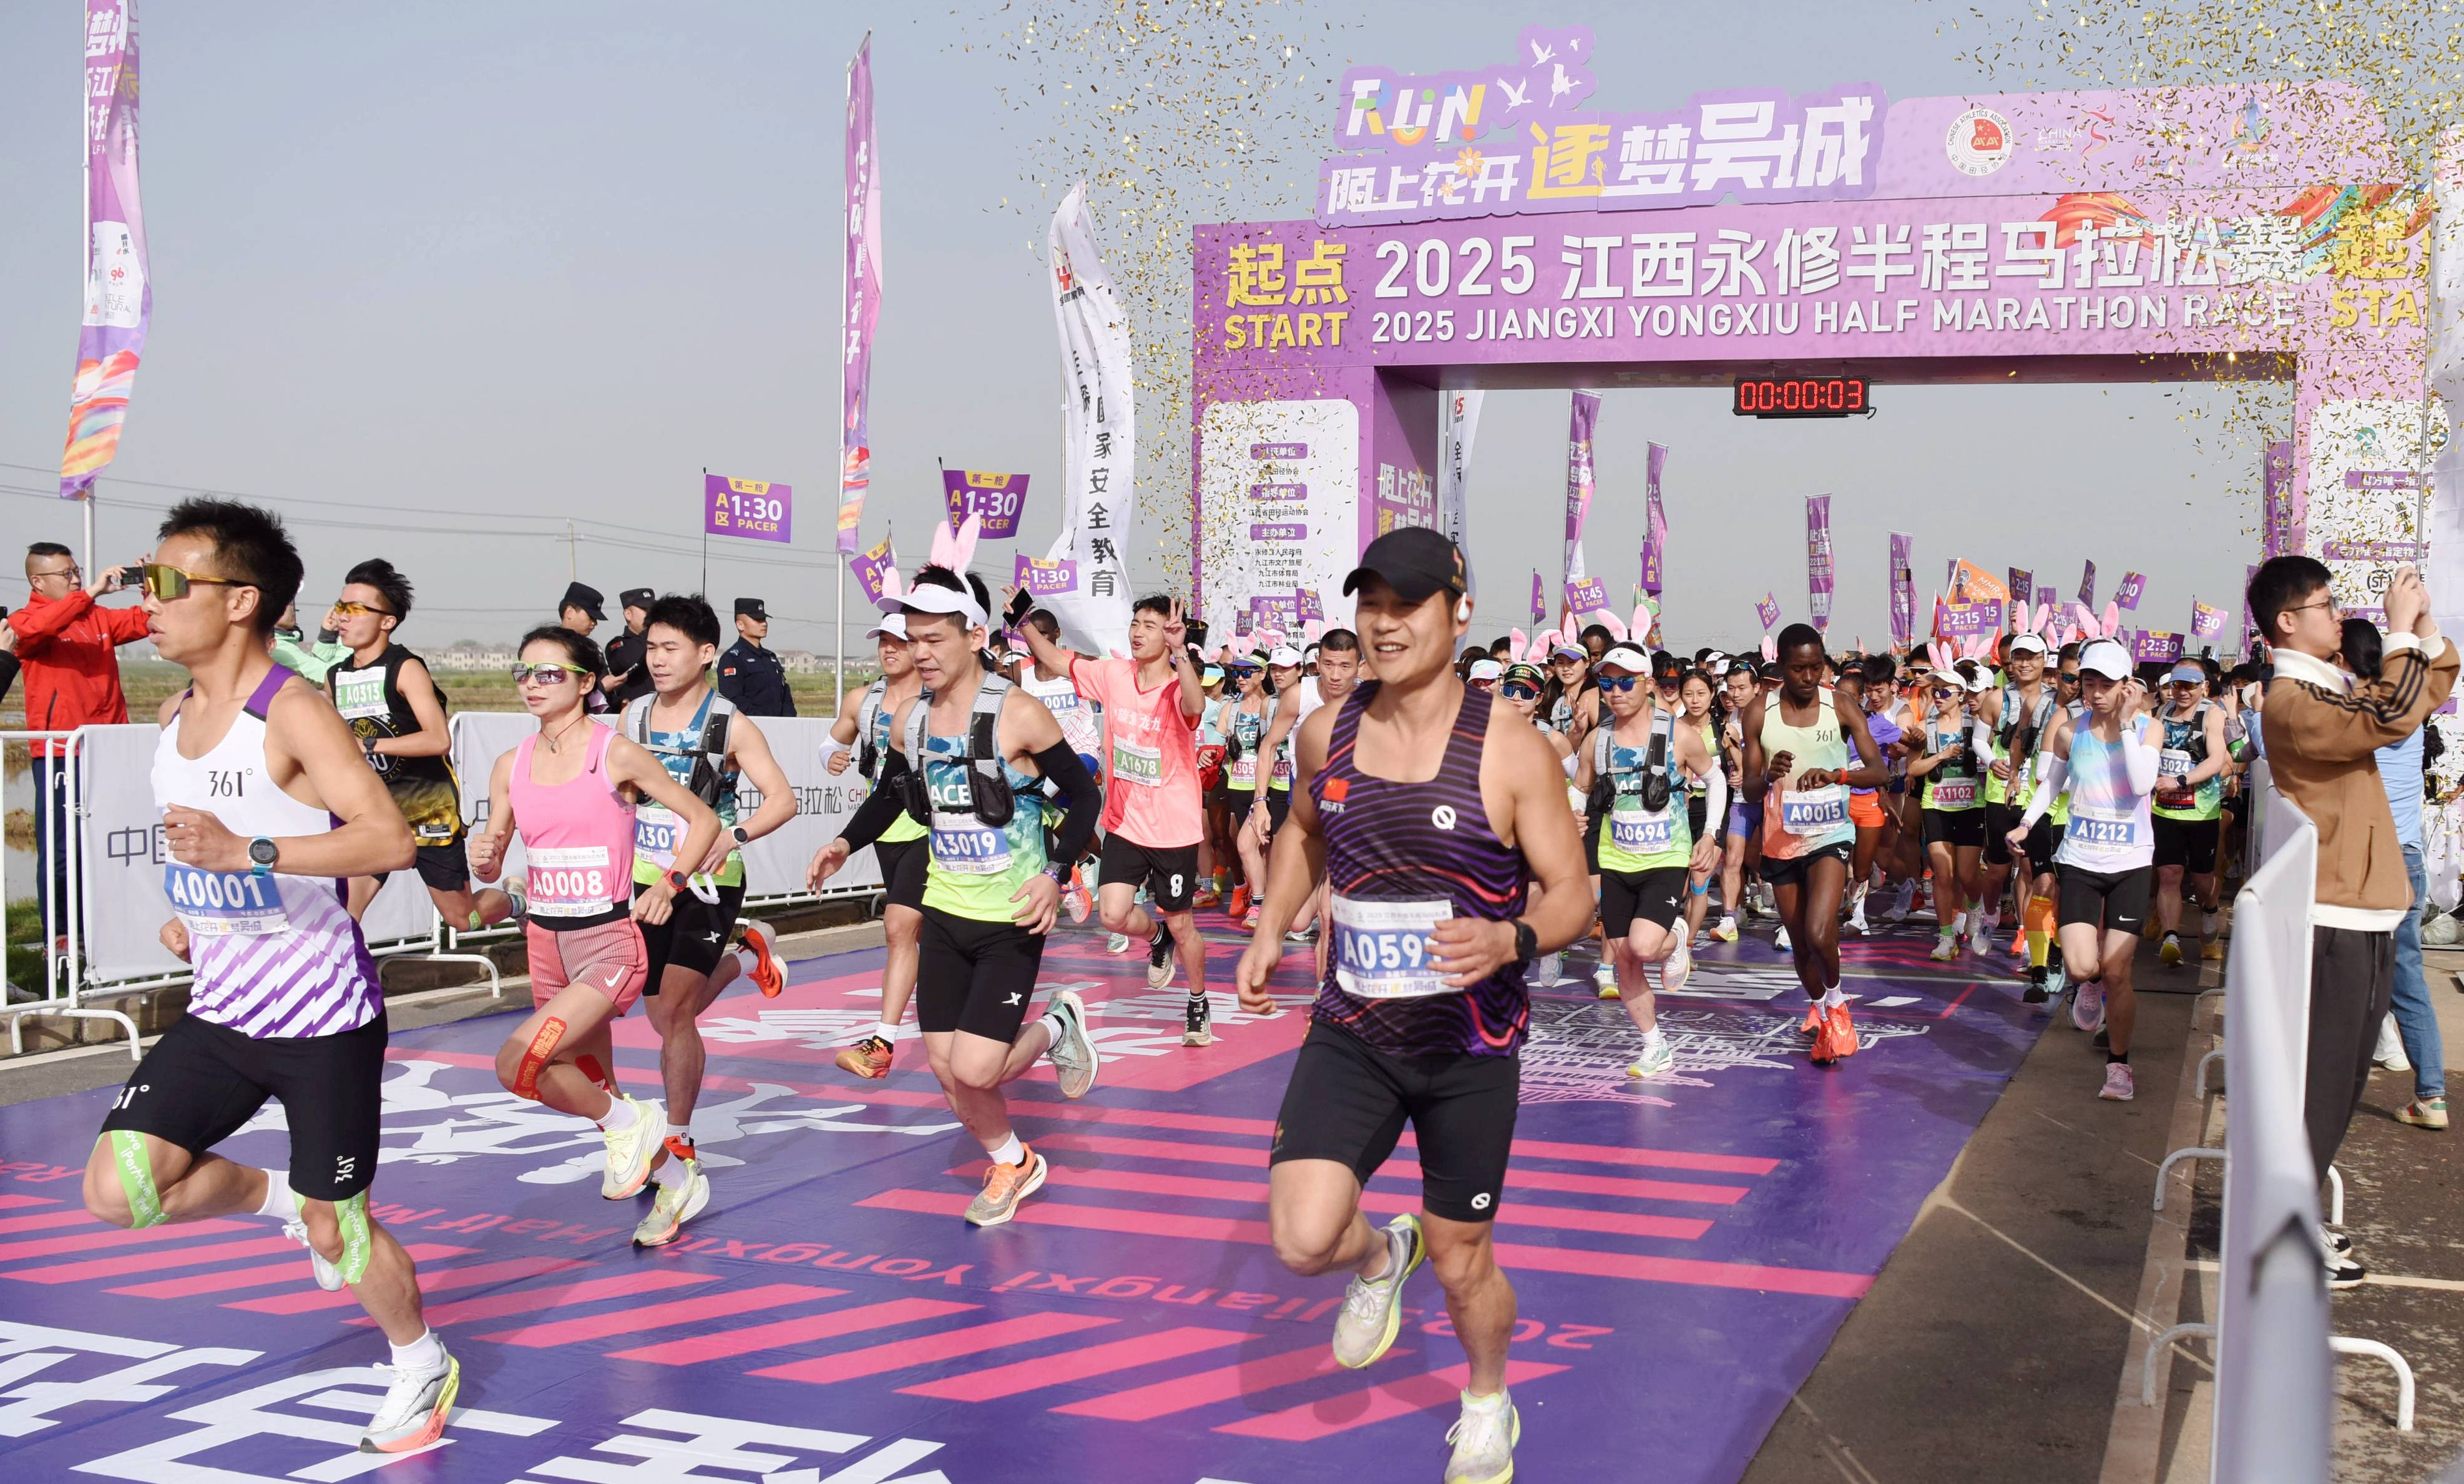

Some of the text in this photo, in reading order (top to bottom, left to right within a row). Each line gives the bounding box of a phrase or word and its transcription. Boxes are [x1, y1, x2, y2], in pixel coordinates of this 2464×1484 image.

[1346, 79, 1486, 142] RUN
[1948, 122, 1960, 145] CHINESE
[1960, 110, 1988, 124] ATHLETICS
[2333, 210, 2430, 280] 起
[1375, 215, 2301, 300] 2025 江西永修半程马拉松赛
[1226, 240, 1349, 308] 起点
[1372, 292, 2297, 343] 2025 JIANGXI YONGXIU HALF MARATHON RACE
[2331, 288, 2422, 328] STA
[1224, 311, 1348, 349] START
[1740, 380, 1862, 410] 00:00:03
[734, 479, 763, 494] 第一枪
[972, 474, 1004, 486] 第一枪
[1378, 462, 1434, 509] 陌上花开
[731, 495, 783, 522] 1:30
[966, 491, 1018, 517] 1:30
[737, 519, 778, 532] PACER
[1261, 528, 1296, 537] 主办单位
[1031, 569, 1070, 583] 1:30
[1258, 569, 1299, 577] 九江市体育局
[1037, 582, 1067, 590] PACER
[1580, 588, 1603, 602] 1:45
[2016, 578, 2029, 593] 2:15
[1585, 599, 1603, 608] PACER
[1951, 612, 1980, 625] 2:15
[2196, 627, 2214, 635] ACER
[2146, 639, 2178, 652] 2:30
[346, 683, 380, 704] A0313
[1044, 695, 1075, 709] 0014
[1121, 754, 1157, 774] A1678
[1232, 763, 1255, 774] A305
[1937, 787, 1972, 799] A1102
[1790, 802, 1841, 822] A0015
[1615, 823, 1666, 841] A0694
[2076, 819, 2128, 842] A1212
[936, 831, 996, 856] A3019
[172, 870, 265, 909] A0001
[533, 870, 604, 897] A0008
[1170, 873, 1184, 898] 8
[421, 1213, 622, 1245] Half
[665, 1234, 974, 1287] Yongxi
[989, 1271, 1346, 1322] Jiangxi
